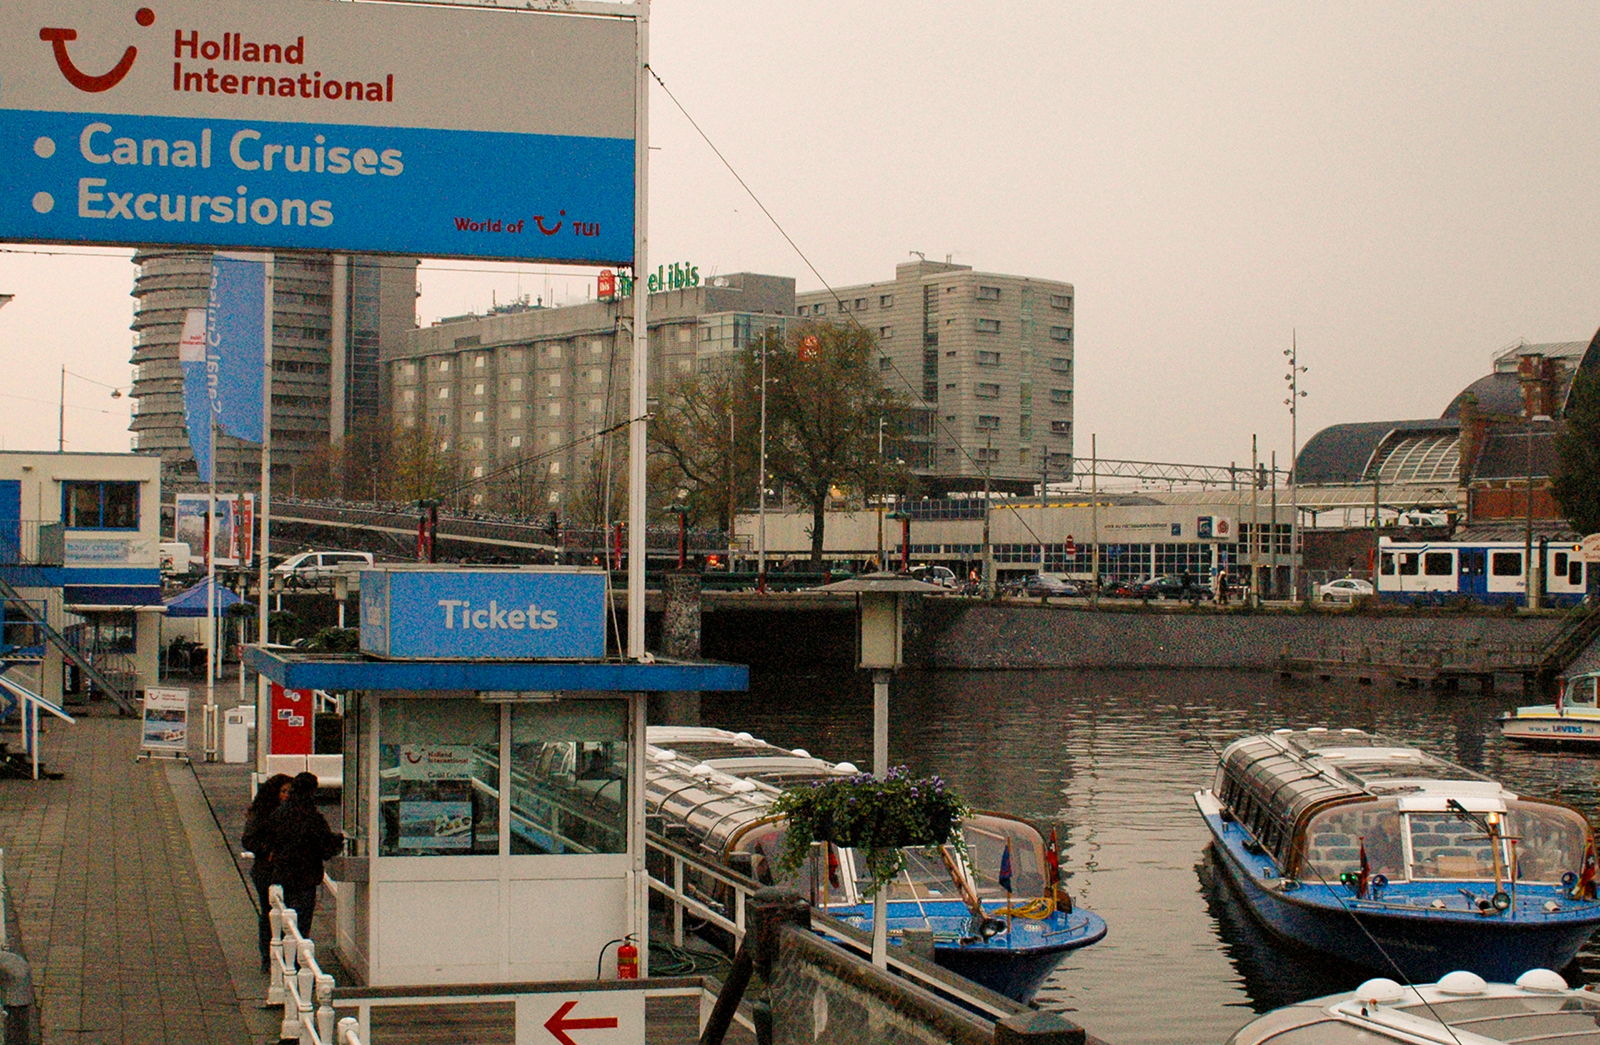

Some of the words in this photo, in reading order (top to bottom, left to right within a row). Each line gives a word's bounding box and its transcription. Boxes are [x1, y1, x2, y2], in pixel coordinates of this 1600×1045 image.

[174, 29, 305, 64] Holland
[173, 61, 394, 102] International
[79, 122, 212, 168] Canal
[229, 129, 404, 176] Cruises
[77, 177, 334, 227] Excursions
[454, 216, 502, 233] World
[506, 219, 525, 234] of
[573, 221, 600, 237] TUI
[668, 261, 700, 291] ibis
[438, 600, 559, 629] Tickets
